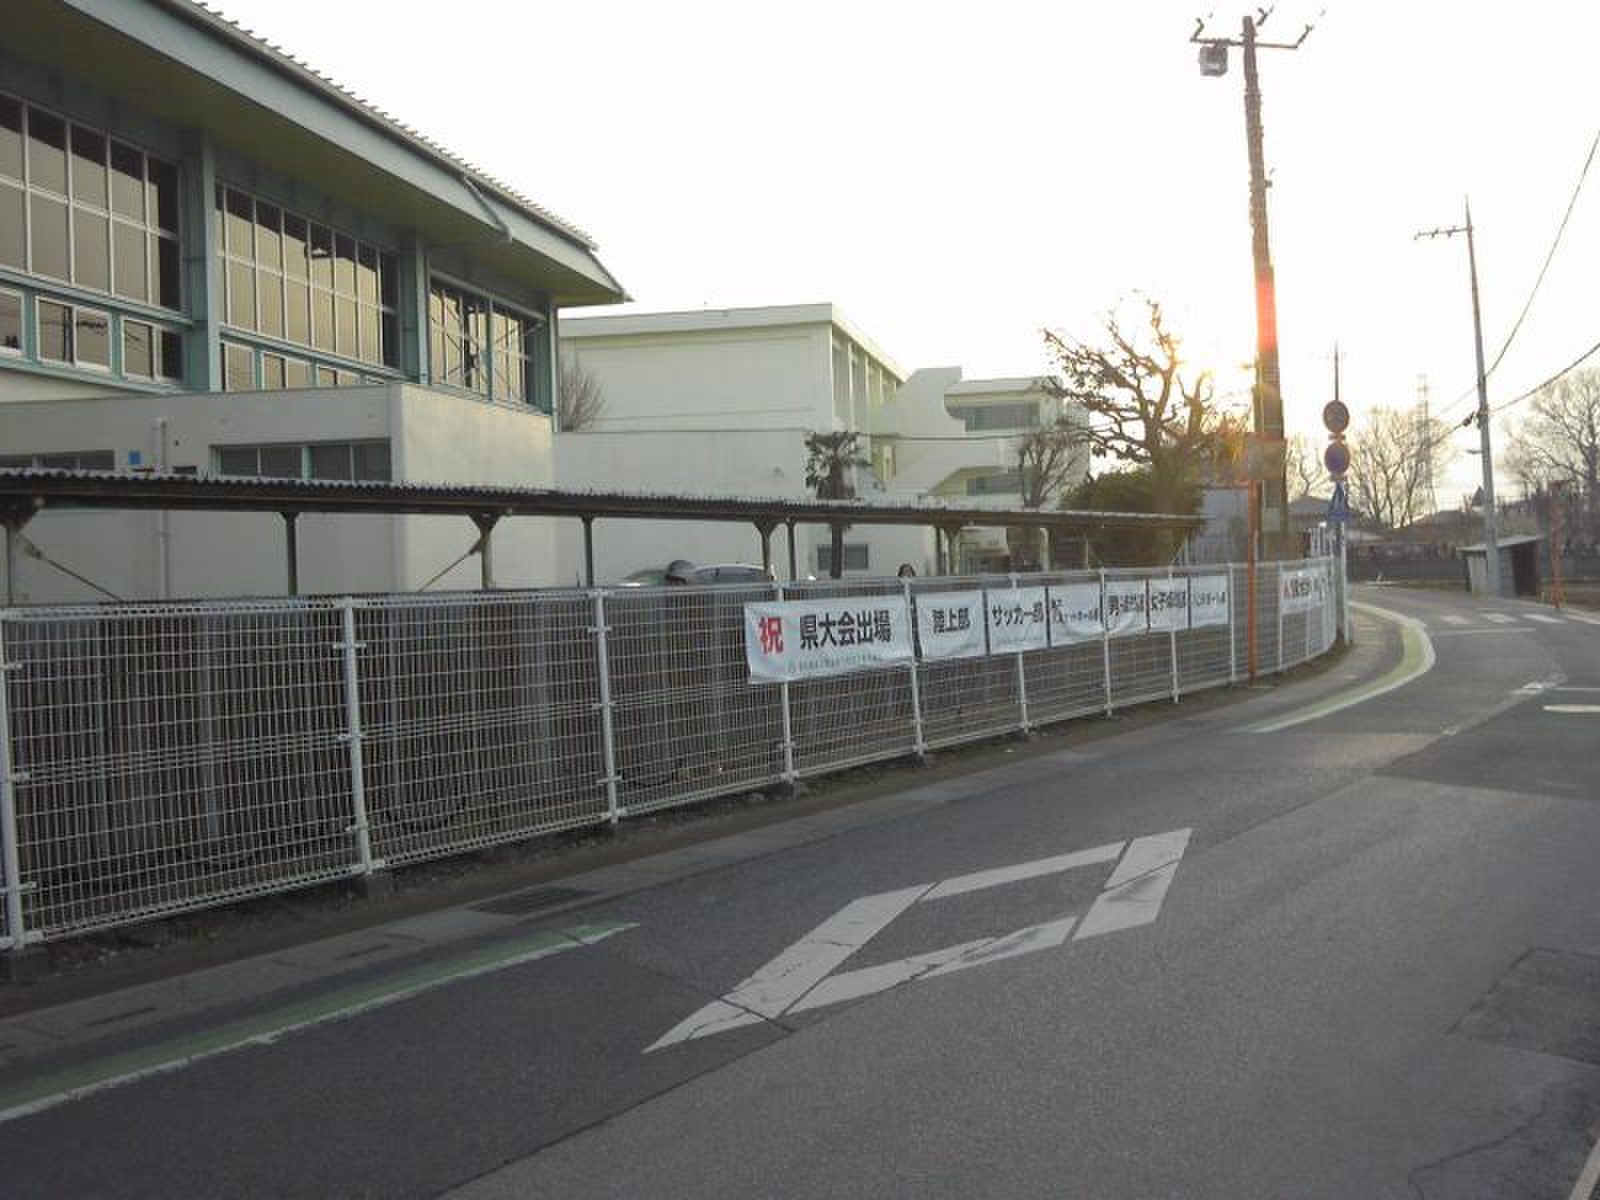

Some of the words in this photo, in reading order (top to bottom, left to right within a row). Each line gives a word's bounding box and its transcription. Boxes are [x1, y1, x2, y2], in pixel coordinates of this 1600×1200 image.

[758, 616, 784, 653] 祝
[799, 610, 892, 650] 県大会出場
